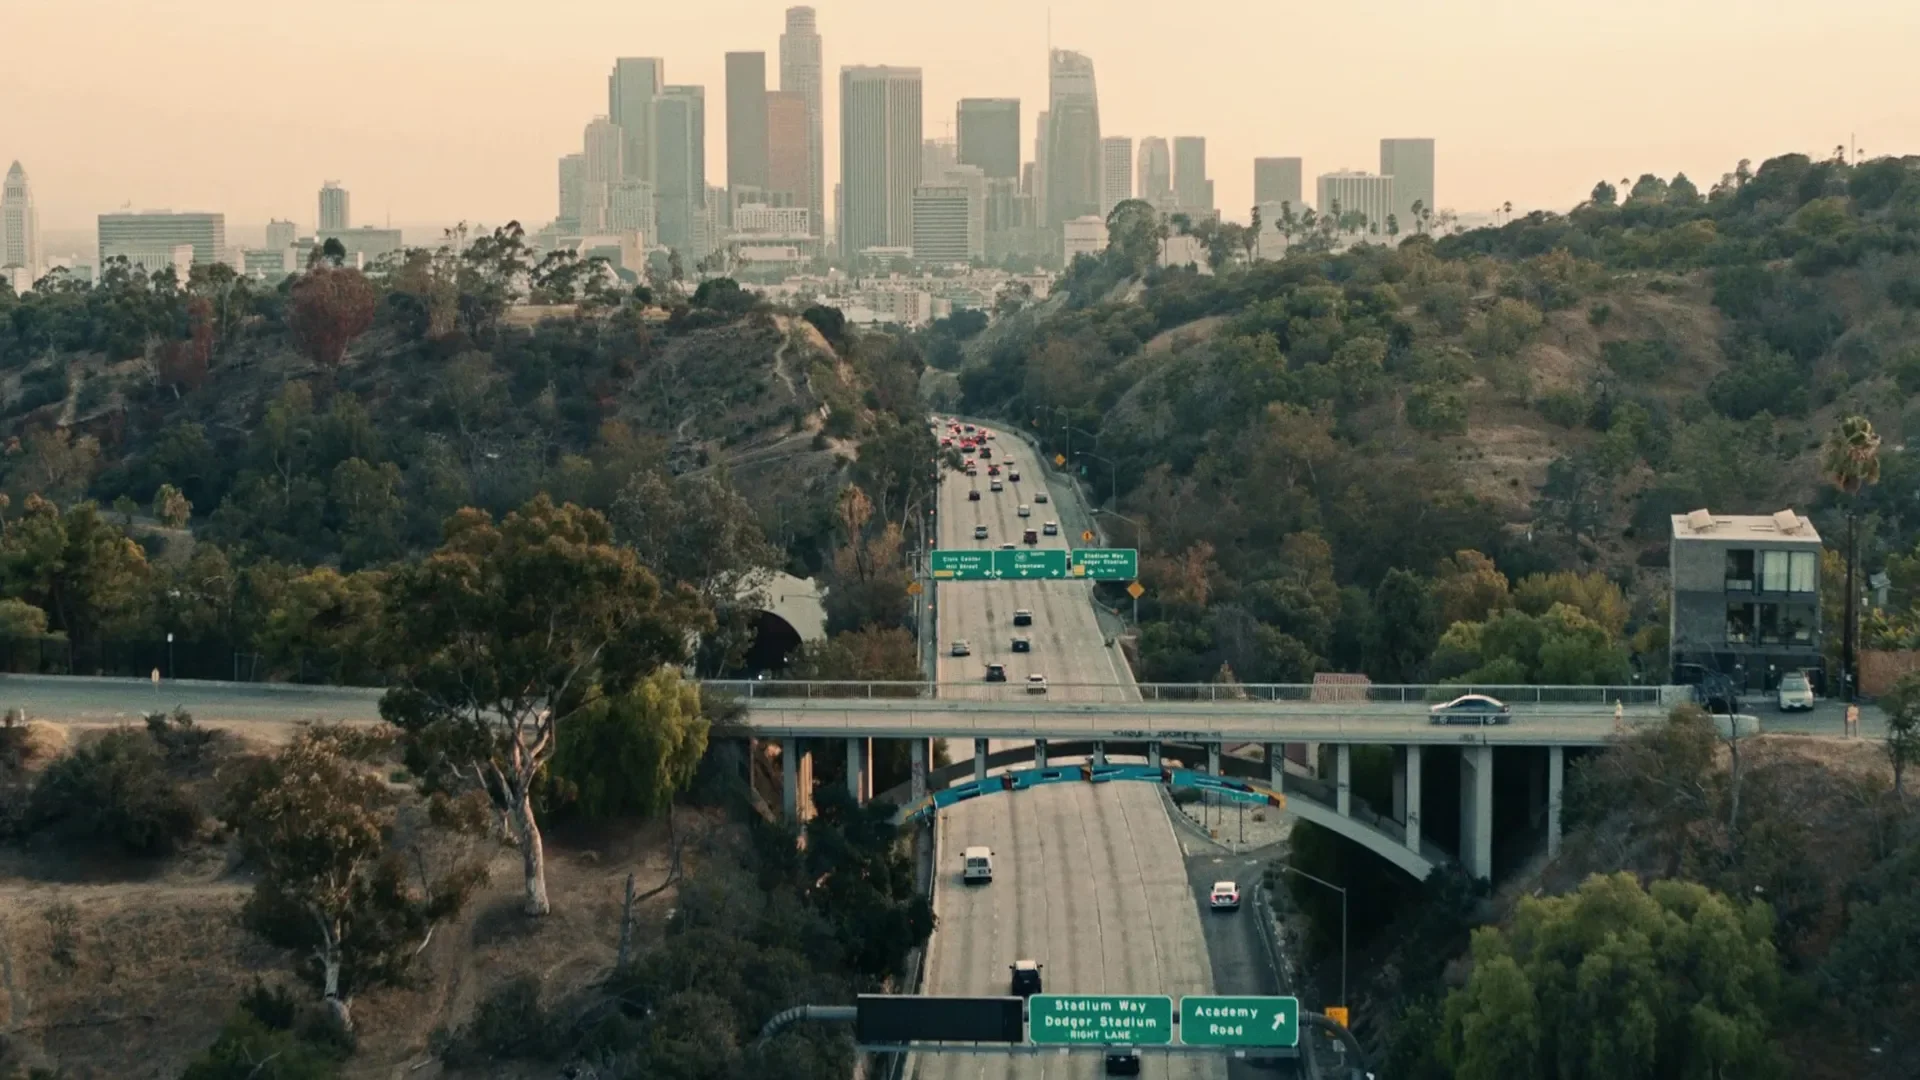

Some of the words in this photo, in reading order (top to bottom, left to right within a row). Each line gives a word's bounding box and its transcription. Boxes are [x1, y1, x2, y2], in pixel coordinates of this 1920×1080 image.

[1055, 999, 1112, 1011] Stadium
[1119, 1000, 1147, 1014] Way
[1195, 1005, 1259, 1019] Academy
[1045, 1015, 1093, 1029] Dodger
[1099, 1015, 1157, 1028] Stadium
[1070, 1030, 1100, 1039] RIGHT
[1105, 1030, 1131, 1039] LANE
[1209, 1023, 1244, 1036] Road
